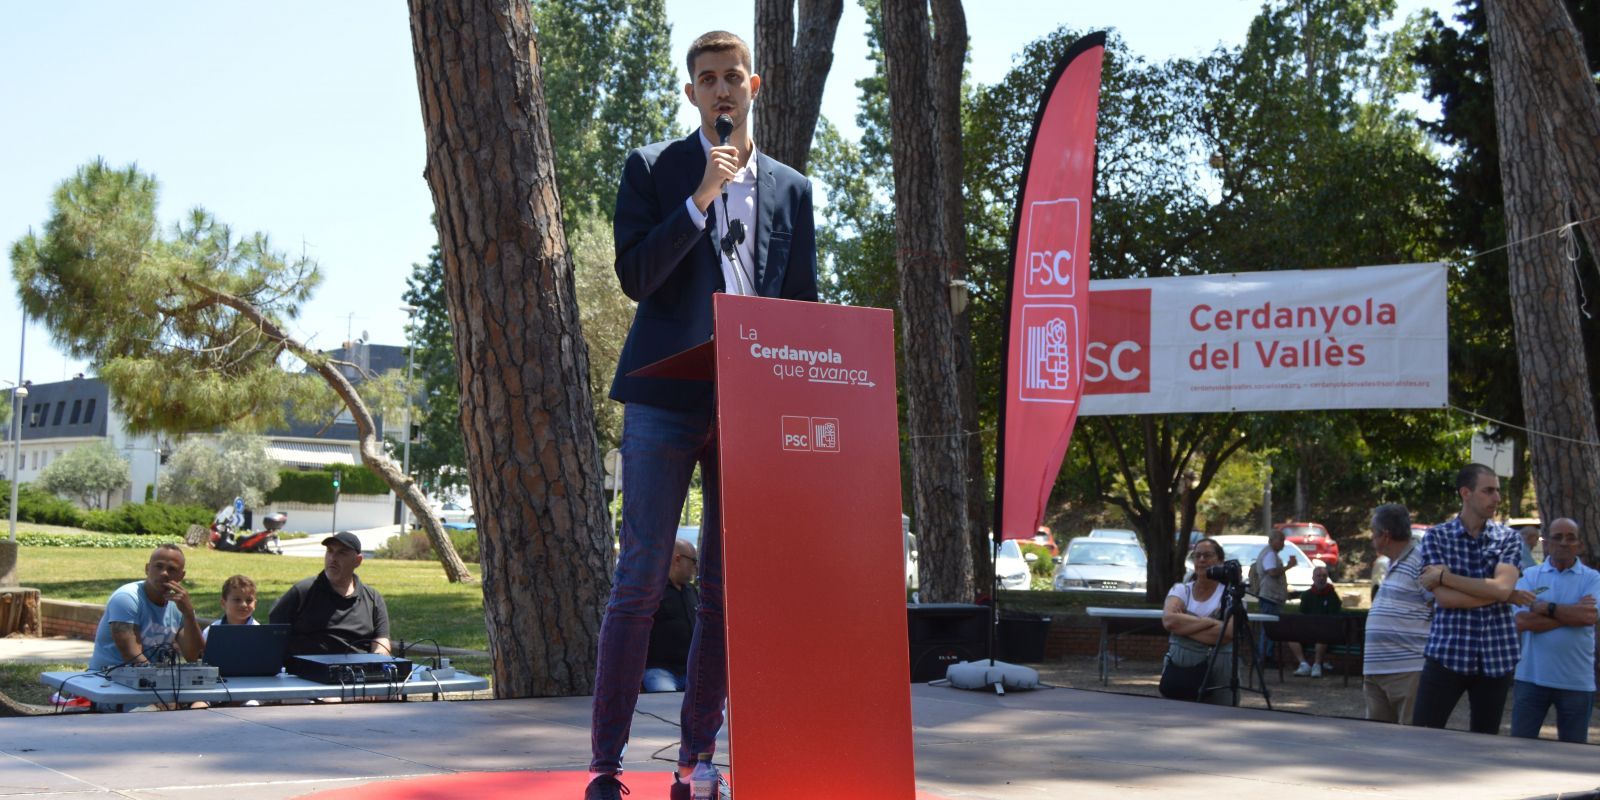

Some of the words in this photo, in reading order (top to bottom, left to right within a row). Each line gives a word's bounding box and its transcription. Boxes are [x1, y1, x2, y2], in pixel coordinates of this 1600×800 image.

[1029, 249, 1072, 286] PSC
[1189, 298, 1396, 333] Cerdanyola
[739, 323, 758, 341] La
[750, 343, 842, 365] Cerdanyola
[1084, 340, 1141, 383] SC
[1189, 342, 1239, 371] del
[1255, 336, 1366, 369] Vallès
[773, 363, 804, 380] que
[808, 366, 868, 385] avança
[785, 434, 808, 447] PSC
